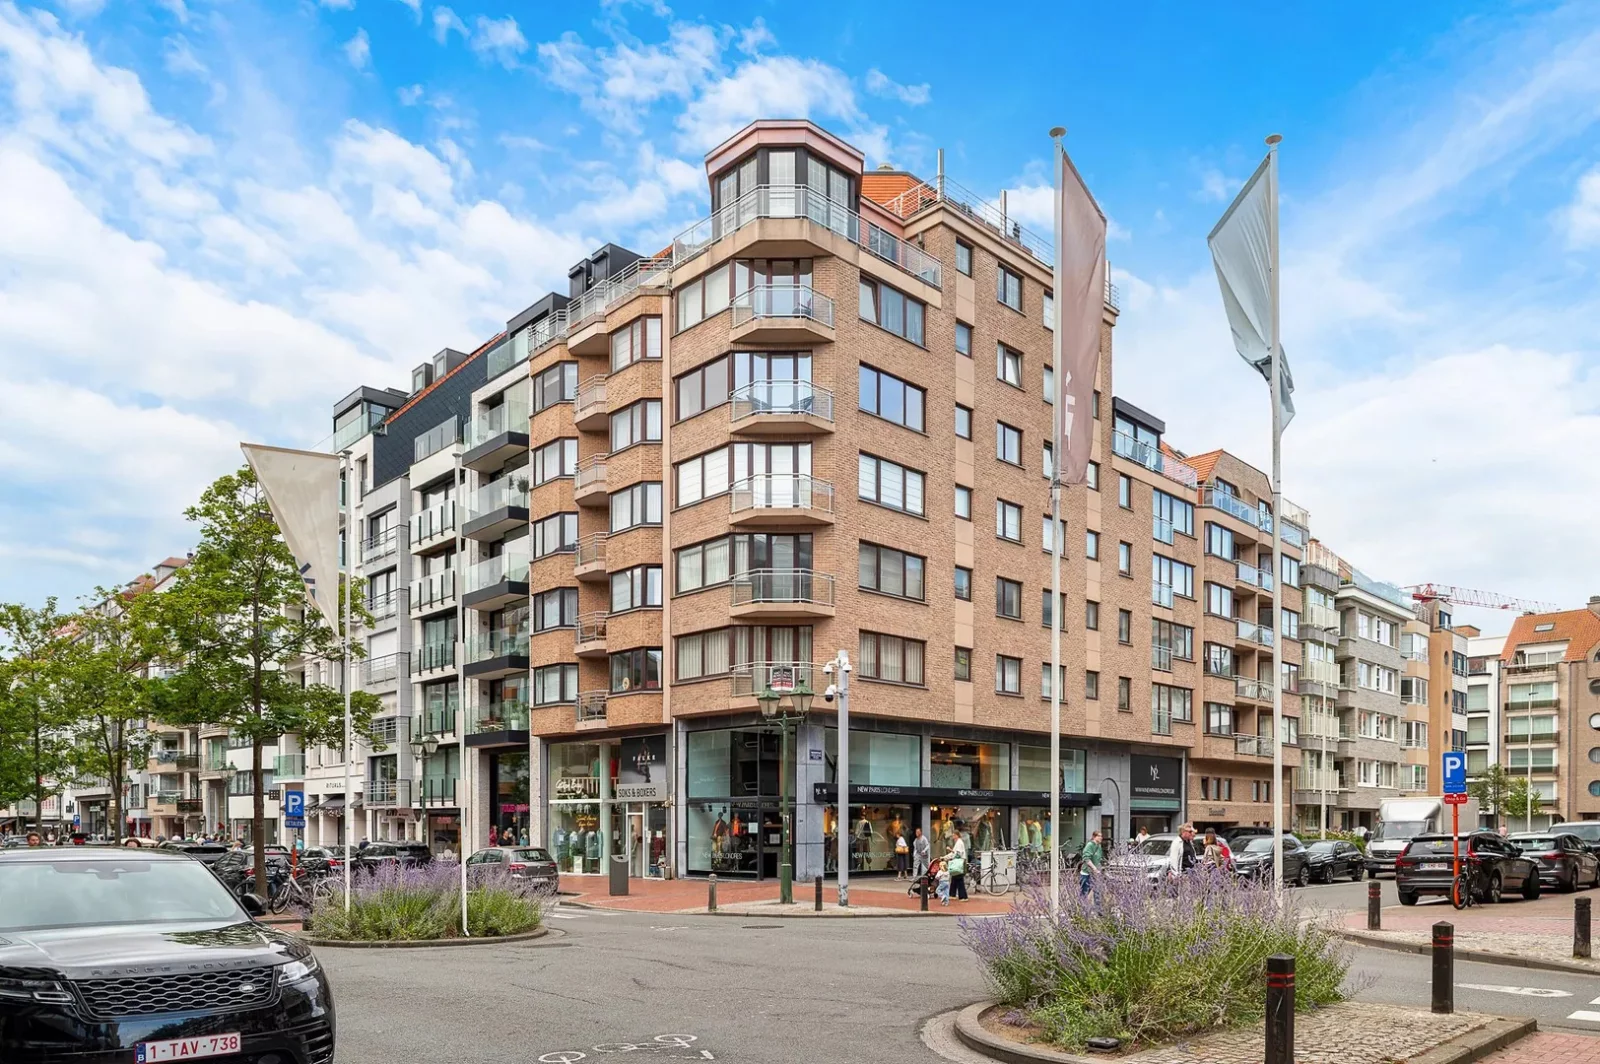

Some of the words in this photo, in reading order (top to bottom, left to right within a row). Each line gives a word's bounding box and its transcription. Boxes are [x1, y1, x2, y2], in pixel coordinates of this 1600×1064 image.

[1445, 757, 1461, 778] P
[637, 787, 657, 797] BOXERS
[857, 785, 869, 793] NEW
[288, 794, 301, 813] P
[150, 1036, 238, 1059] 1-TAV-738
